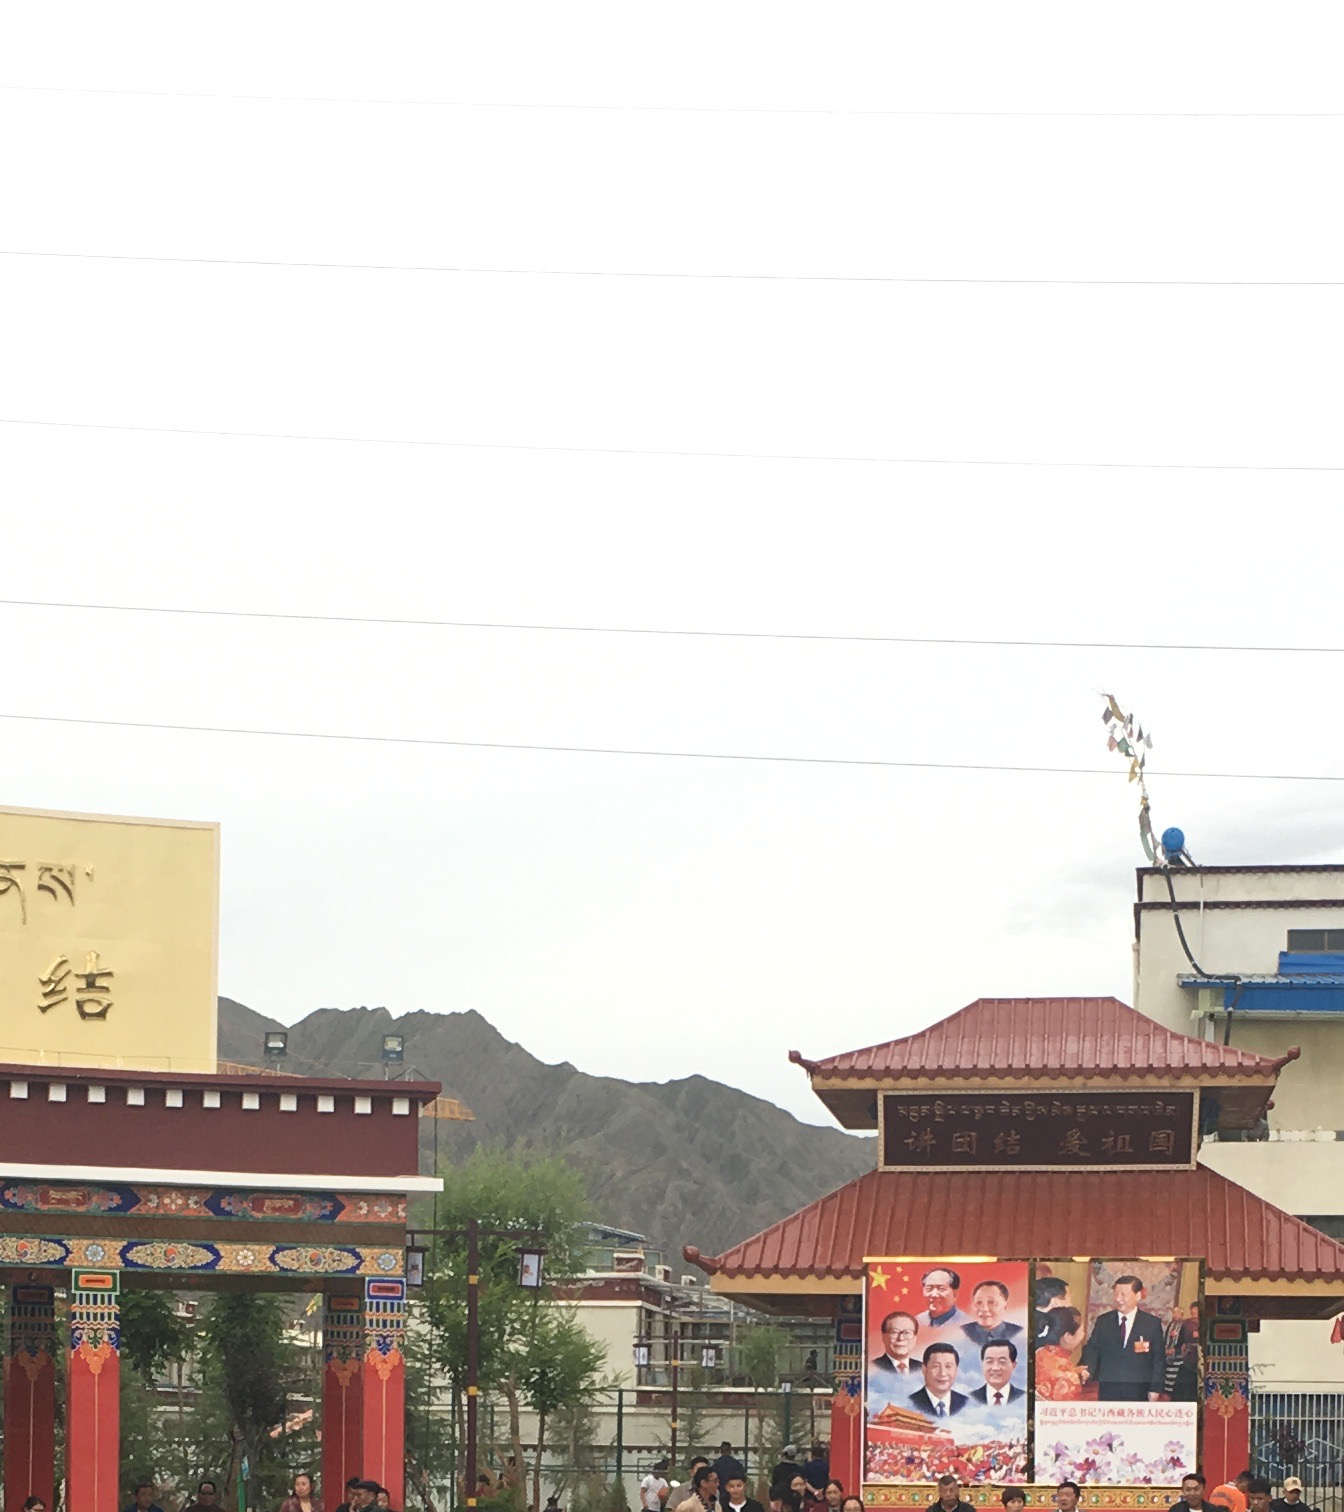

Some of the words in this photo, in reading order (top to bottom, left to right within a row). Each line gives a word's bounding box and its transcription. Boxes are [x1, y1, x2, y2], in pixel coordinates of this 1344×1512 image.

[903, 1127, 1023, 1157] 讲团结
[1058, 1128, 1176, 1157] 爱祖国
[1039, 1407, 1194, 1419] 习近平总书记与西藏各族人民心连心
